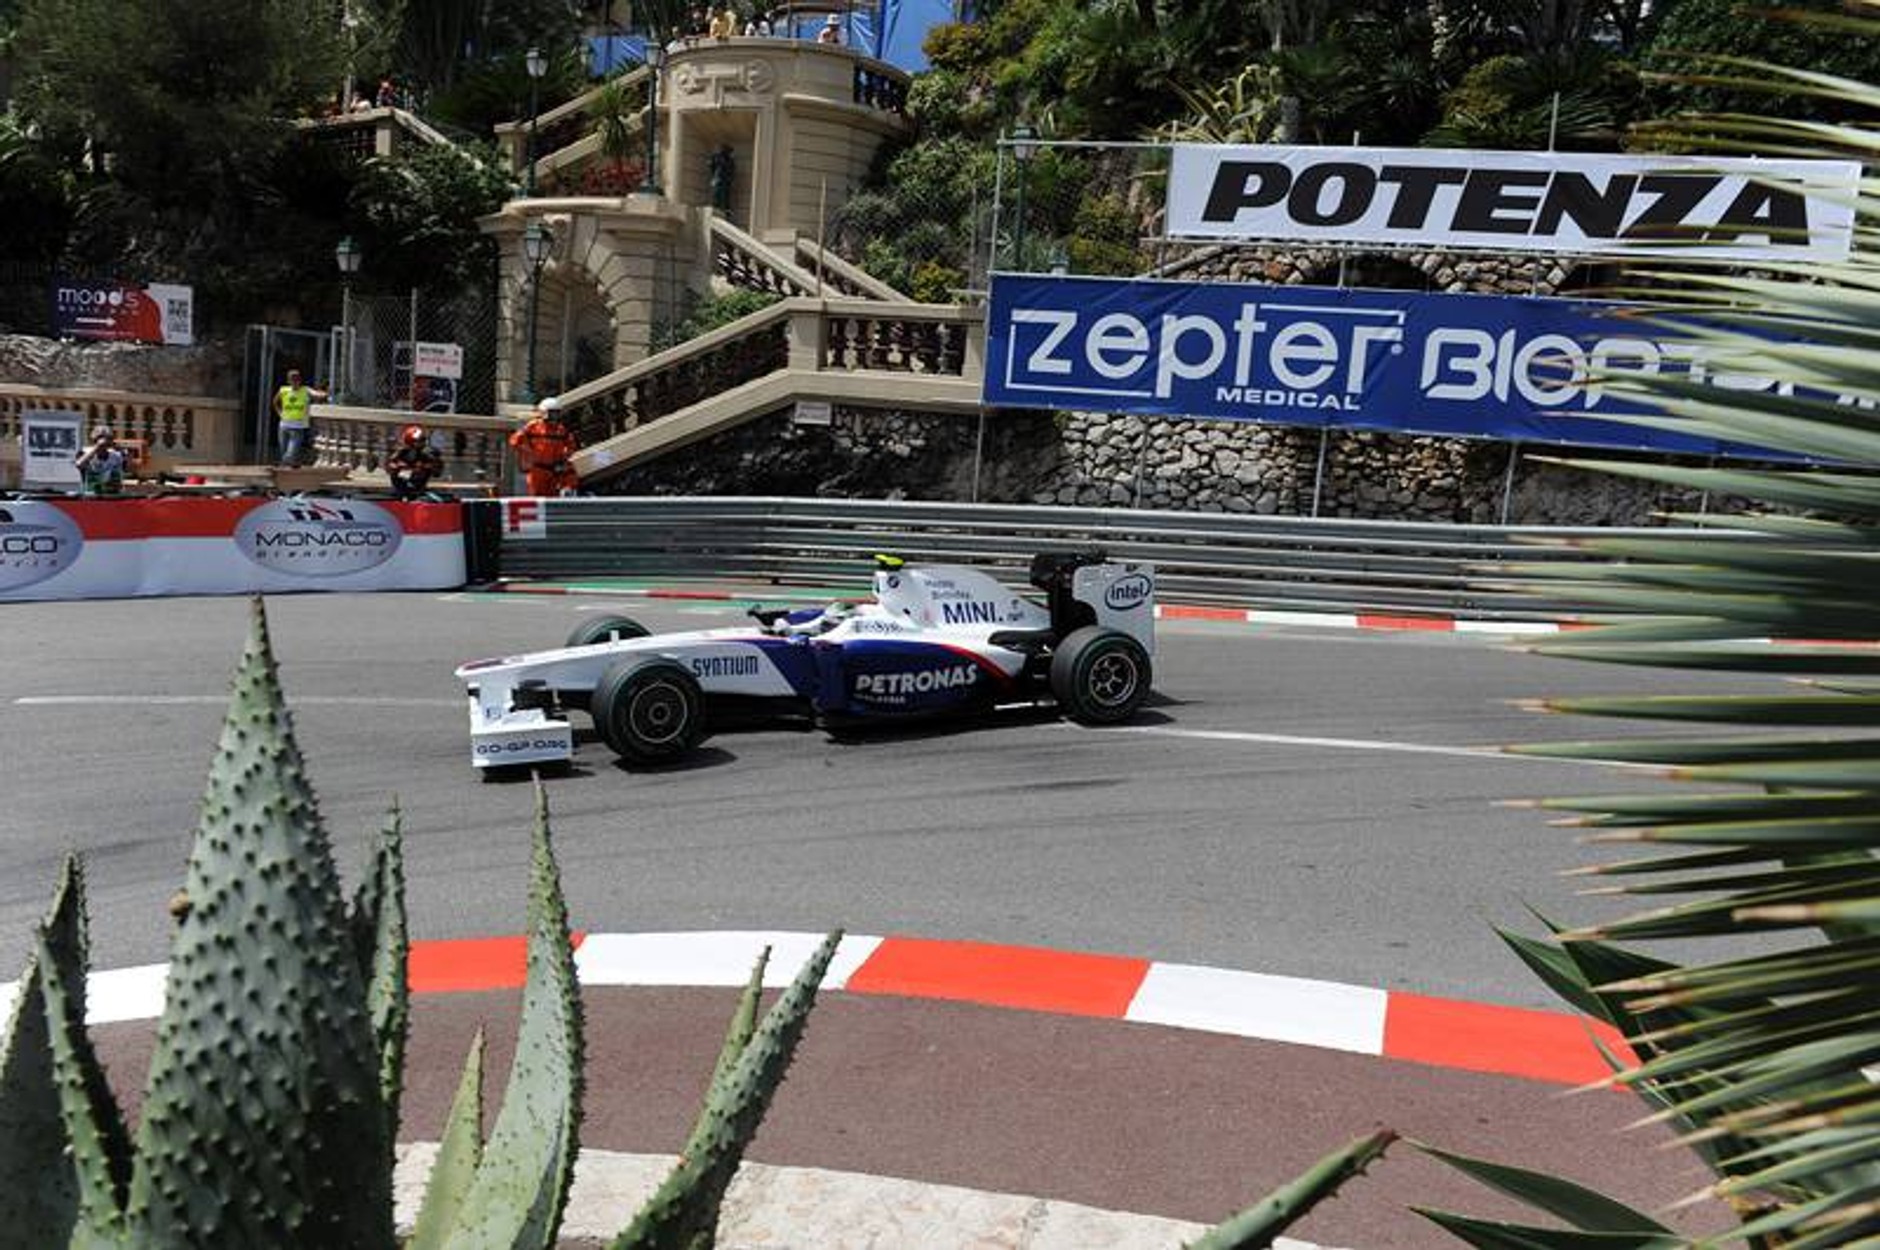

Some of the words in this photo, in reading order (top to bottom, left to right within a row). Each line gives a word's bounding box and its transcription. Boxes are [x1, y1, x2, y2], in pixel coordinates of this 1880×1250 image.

[1202, 160, 1810, 246] POTENZA
[58, 286, 140, 307] moods
[1010, 302, 1404, 398] zepter
[1216, 387, 1361, 411] MEDICAL
[508, 501, 538, 533] F
[256, 531, 386, 547] MONACO
[1111, 581, 1145, 601] intel
[693, 655, 759, 677] SYNTIUM
[855, 664, 978, 694] PETRONAS
